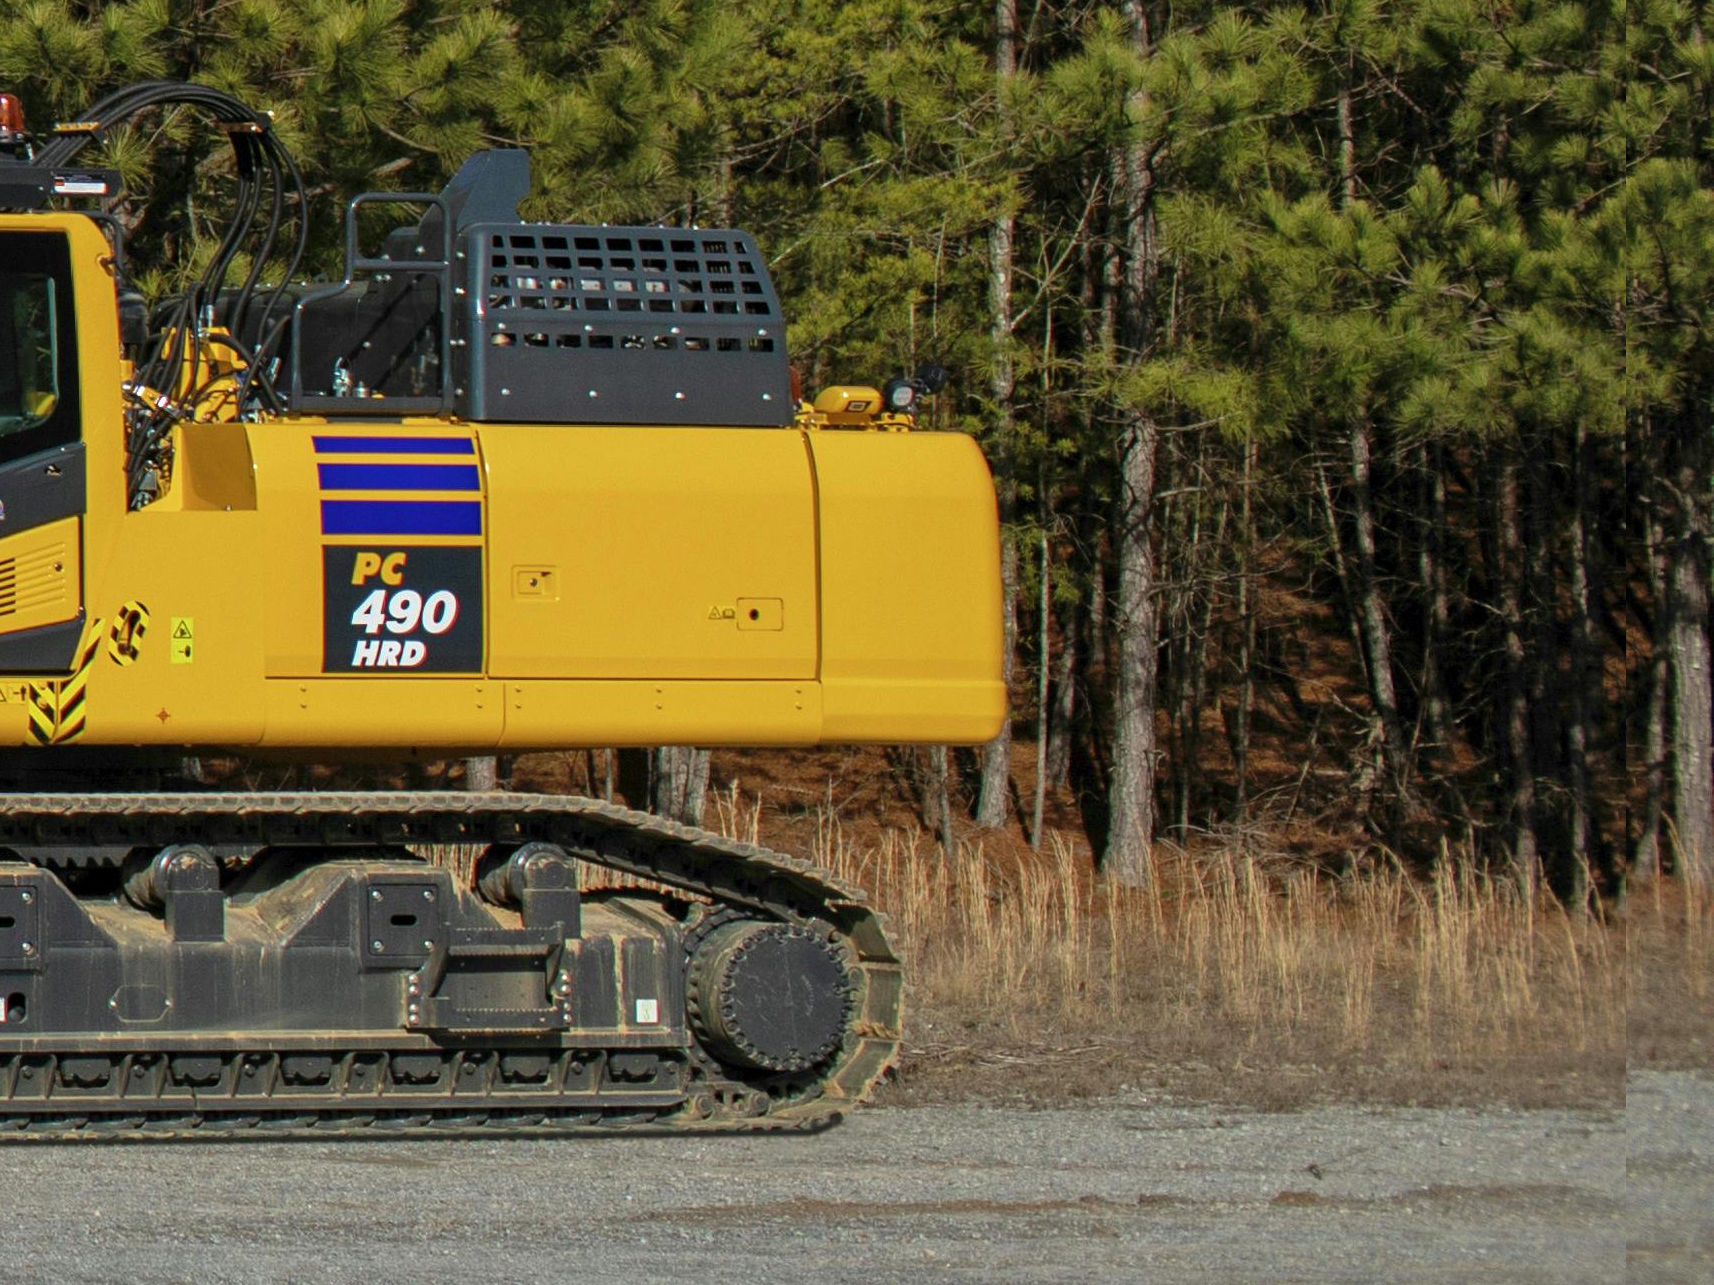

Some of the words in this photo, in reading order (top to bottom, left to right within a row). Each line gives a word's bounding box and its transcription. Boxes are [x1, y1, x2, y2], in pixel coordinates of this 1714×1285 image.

[351, 552, 407, 586] PC
[351, 589, 457, 634] 490
[351, 640, 427, 667] HRD
